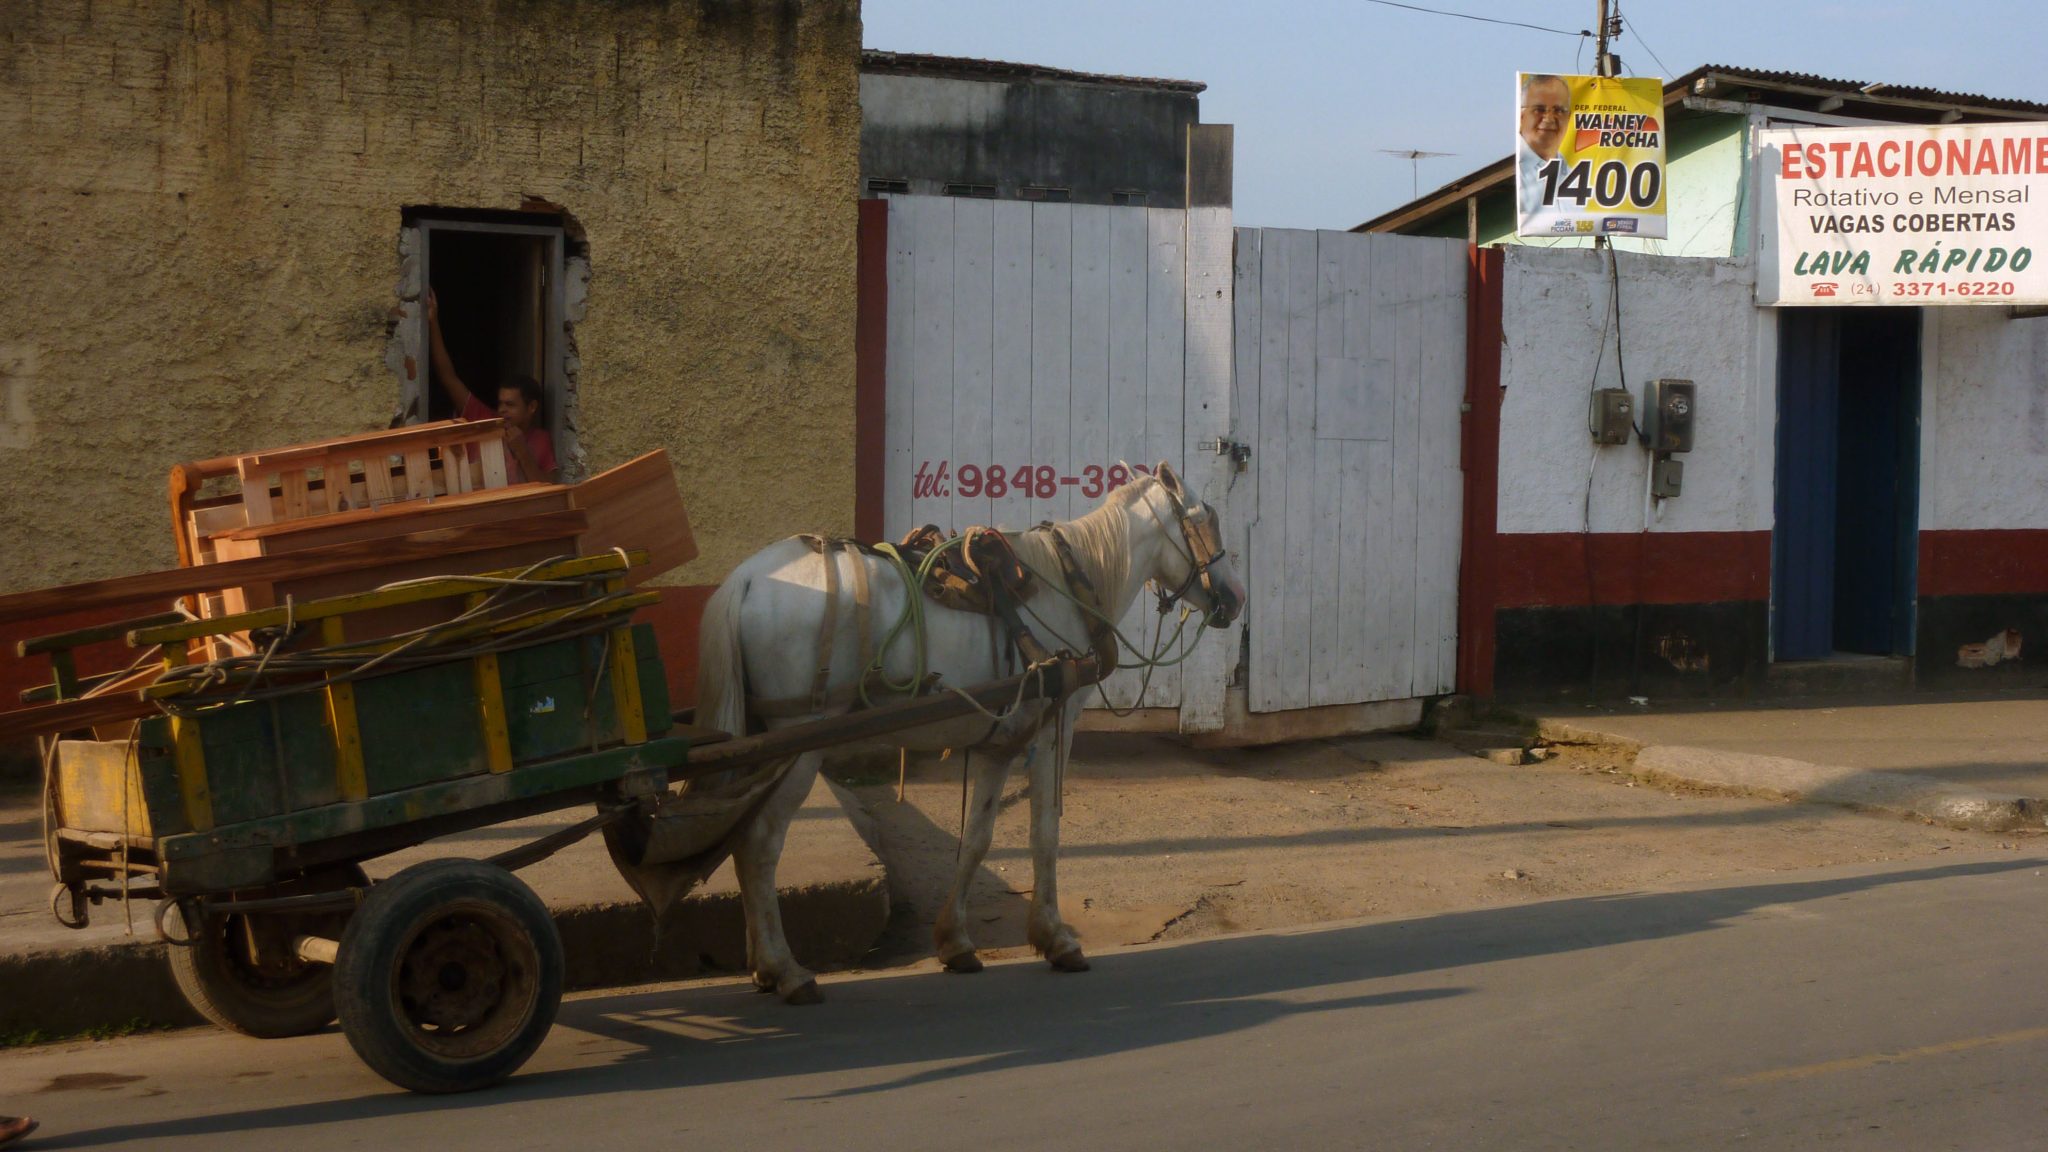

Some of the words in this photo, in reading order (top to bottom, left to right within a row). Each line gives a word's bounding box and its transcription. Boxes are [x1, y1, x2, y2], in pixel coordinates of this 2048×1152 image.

[1593, 104, 1628, 112] FEDERAL
[1574, 113, 1648, 130] WALNEY
[1599, 131, 1659, 148] ROCHA
[1782, 137, 2048, 180] ESTACIONAME
[1538, 160, 1661, 208] 1400
[1793, 188, 1899, 207] Rotativo
[1909, 191, 1923, 205] e
[1934, 185, 2029, 206] Mensal
[1809, 214, 1885, 234] VAGAS
[1893, 212, 2016, 233] COBERTAS
[1793, 249, 1871, 276] LAVA
[1893, 240, 2032, 275] RÁPIDO
[1850, 281, 1881, 296] (24)
[1893, 281, 2015, 296] 3371-6220
[913, 460, 950, 499] tel:
[957, 463, 1162, 499] 9848-38
